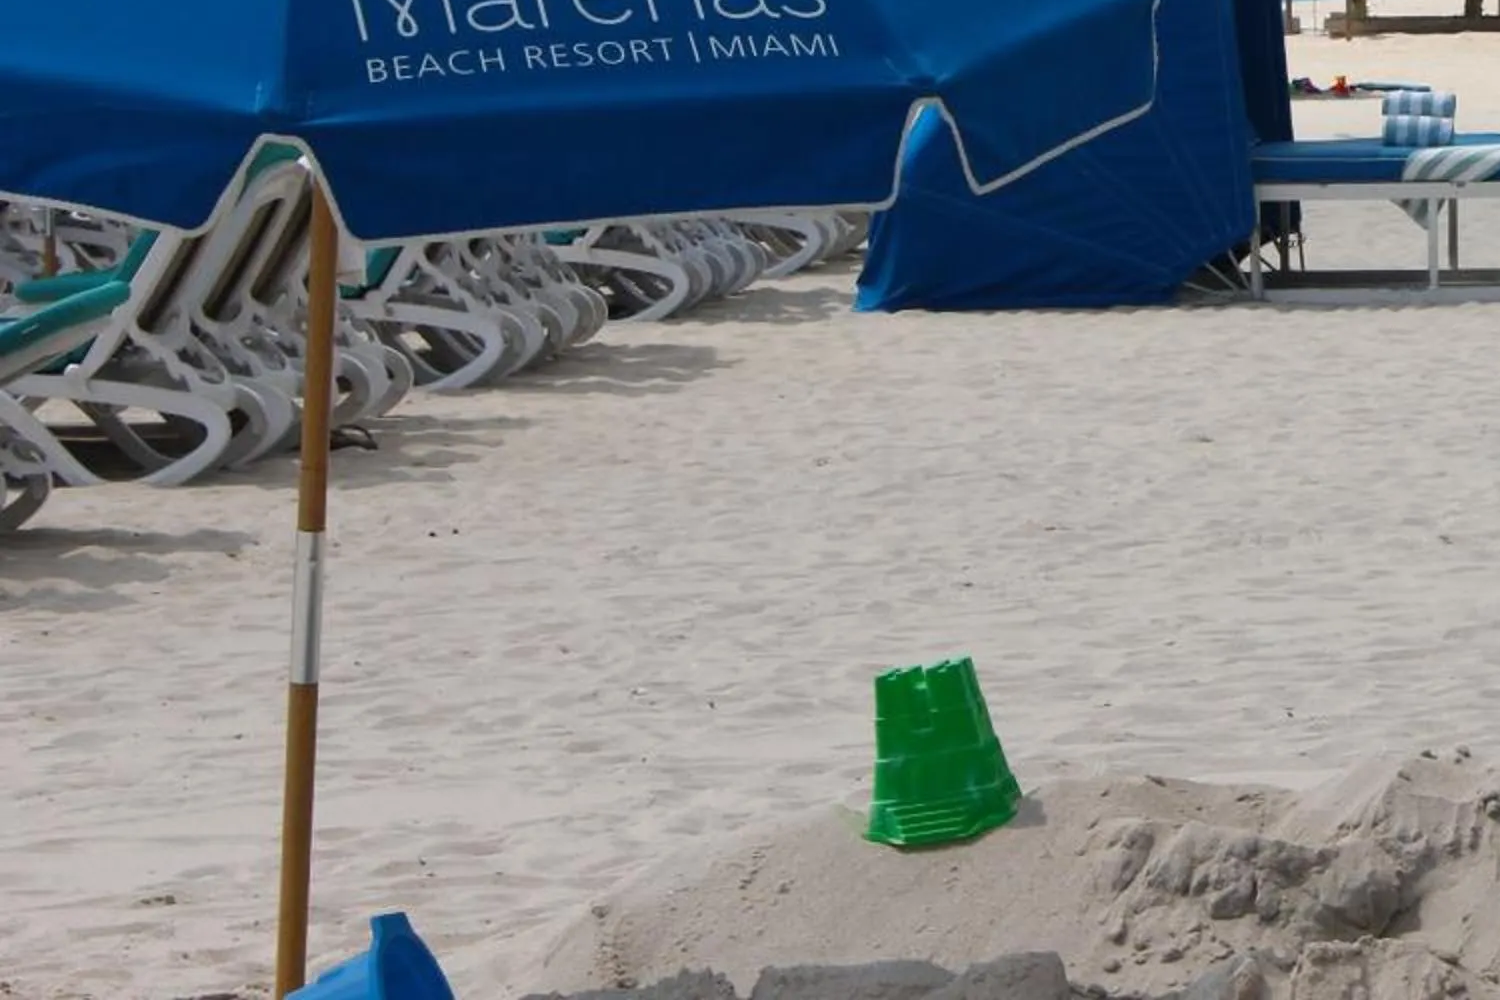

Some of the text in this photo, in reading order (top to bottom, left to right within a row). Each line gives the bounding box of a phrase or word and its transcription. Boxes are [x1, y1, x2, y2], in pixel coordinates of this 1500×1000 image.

[366, 33, 840, 83] BEACH RESORT MIAMI
